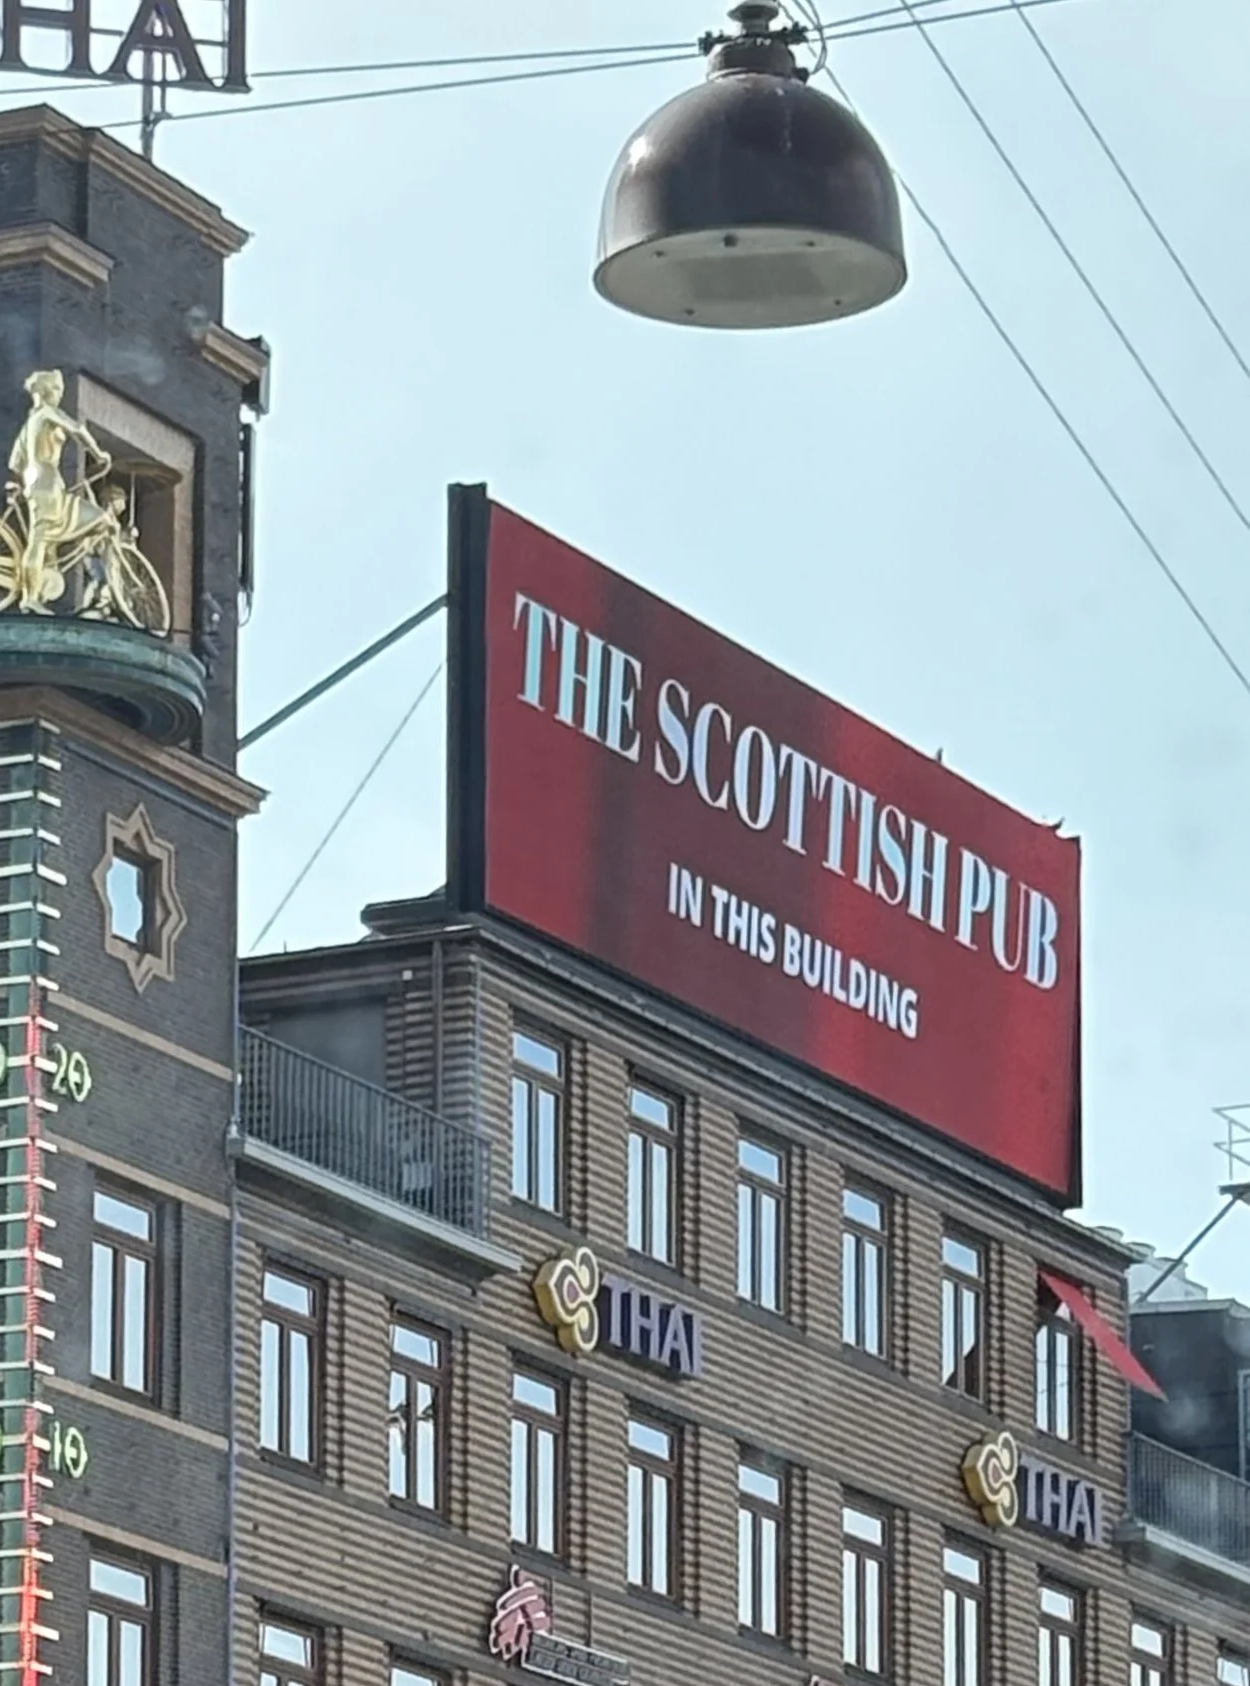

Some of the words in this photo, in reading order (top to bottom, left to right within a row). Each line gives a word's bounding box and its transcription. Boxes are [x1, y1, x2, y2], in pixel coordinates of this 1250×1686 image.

[513, 591, 643, 763] THE
[654, 679, 948, 933] SCOTTISH
[954, 847, 1059, 990] PUB
[668, 863, 703, 928] IN
[711, 884, 776, 965] THIS
[783, 924, 919, 1039] BUILDING
[52, 1042, 91, 1102] 20
[601, 1272, 702, 1378] THAI
[53, 1420, 88, 1478] 10
[1020, 1452, 1103, 1549] THAI
